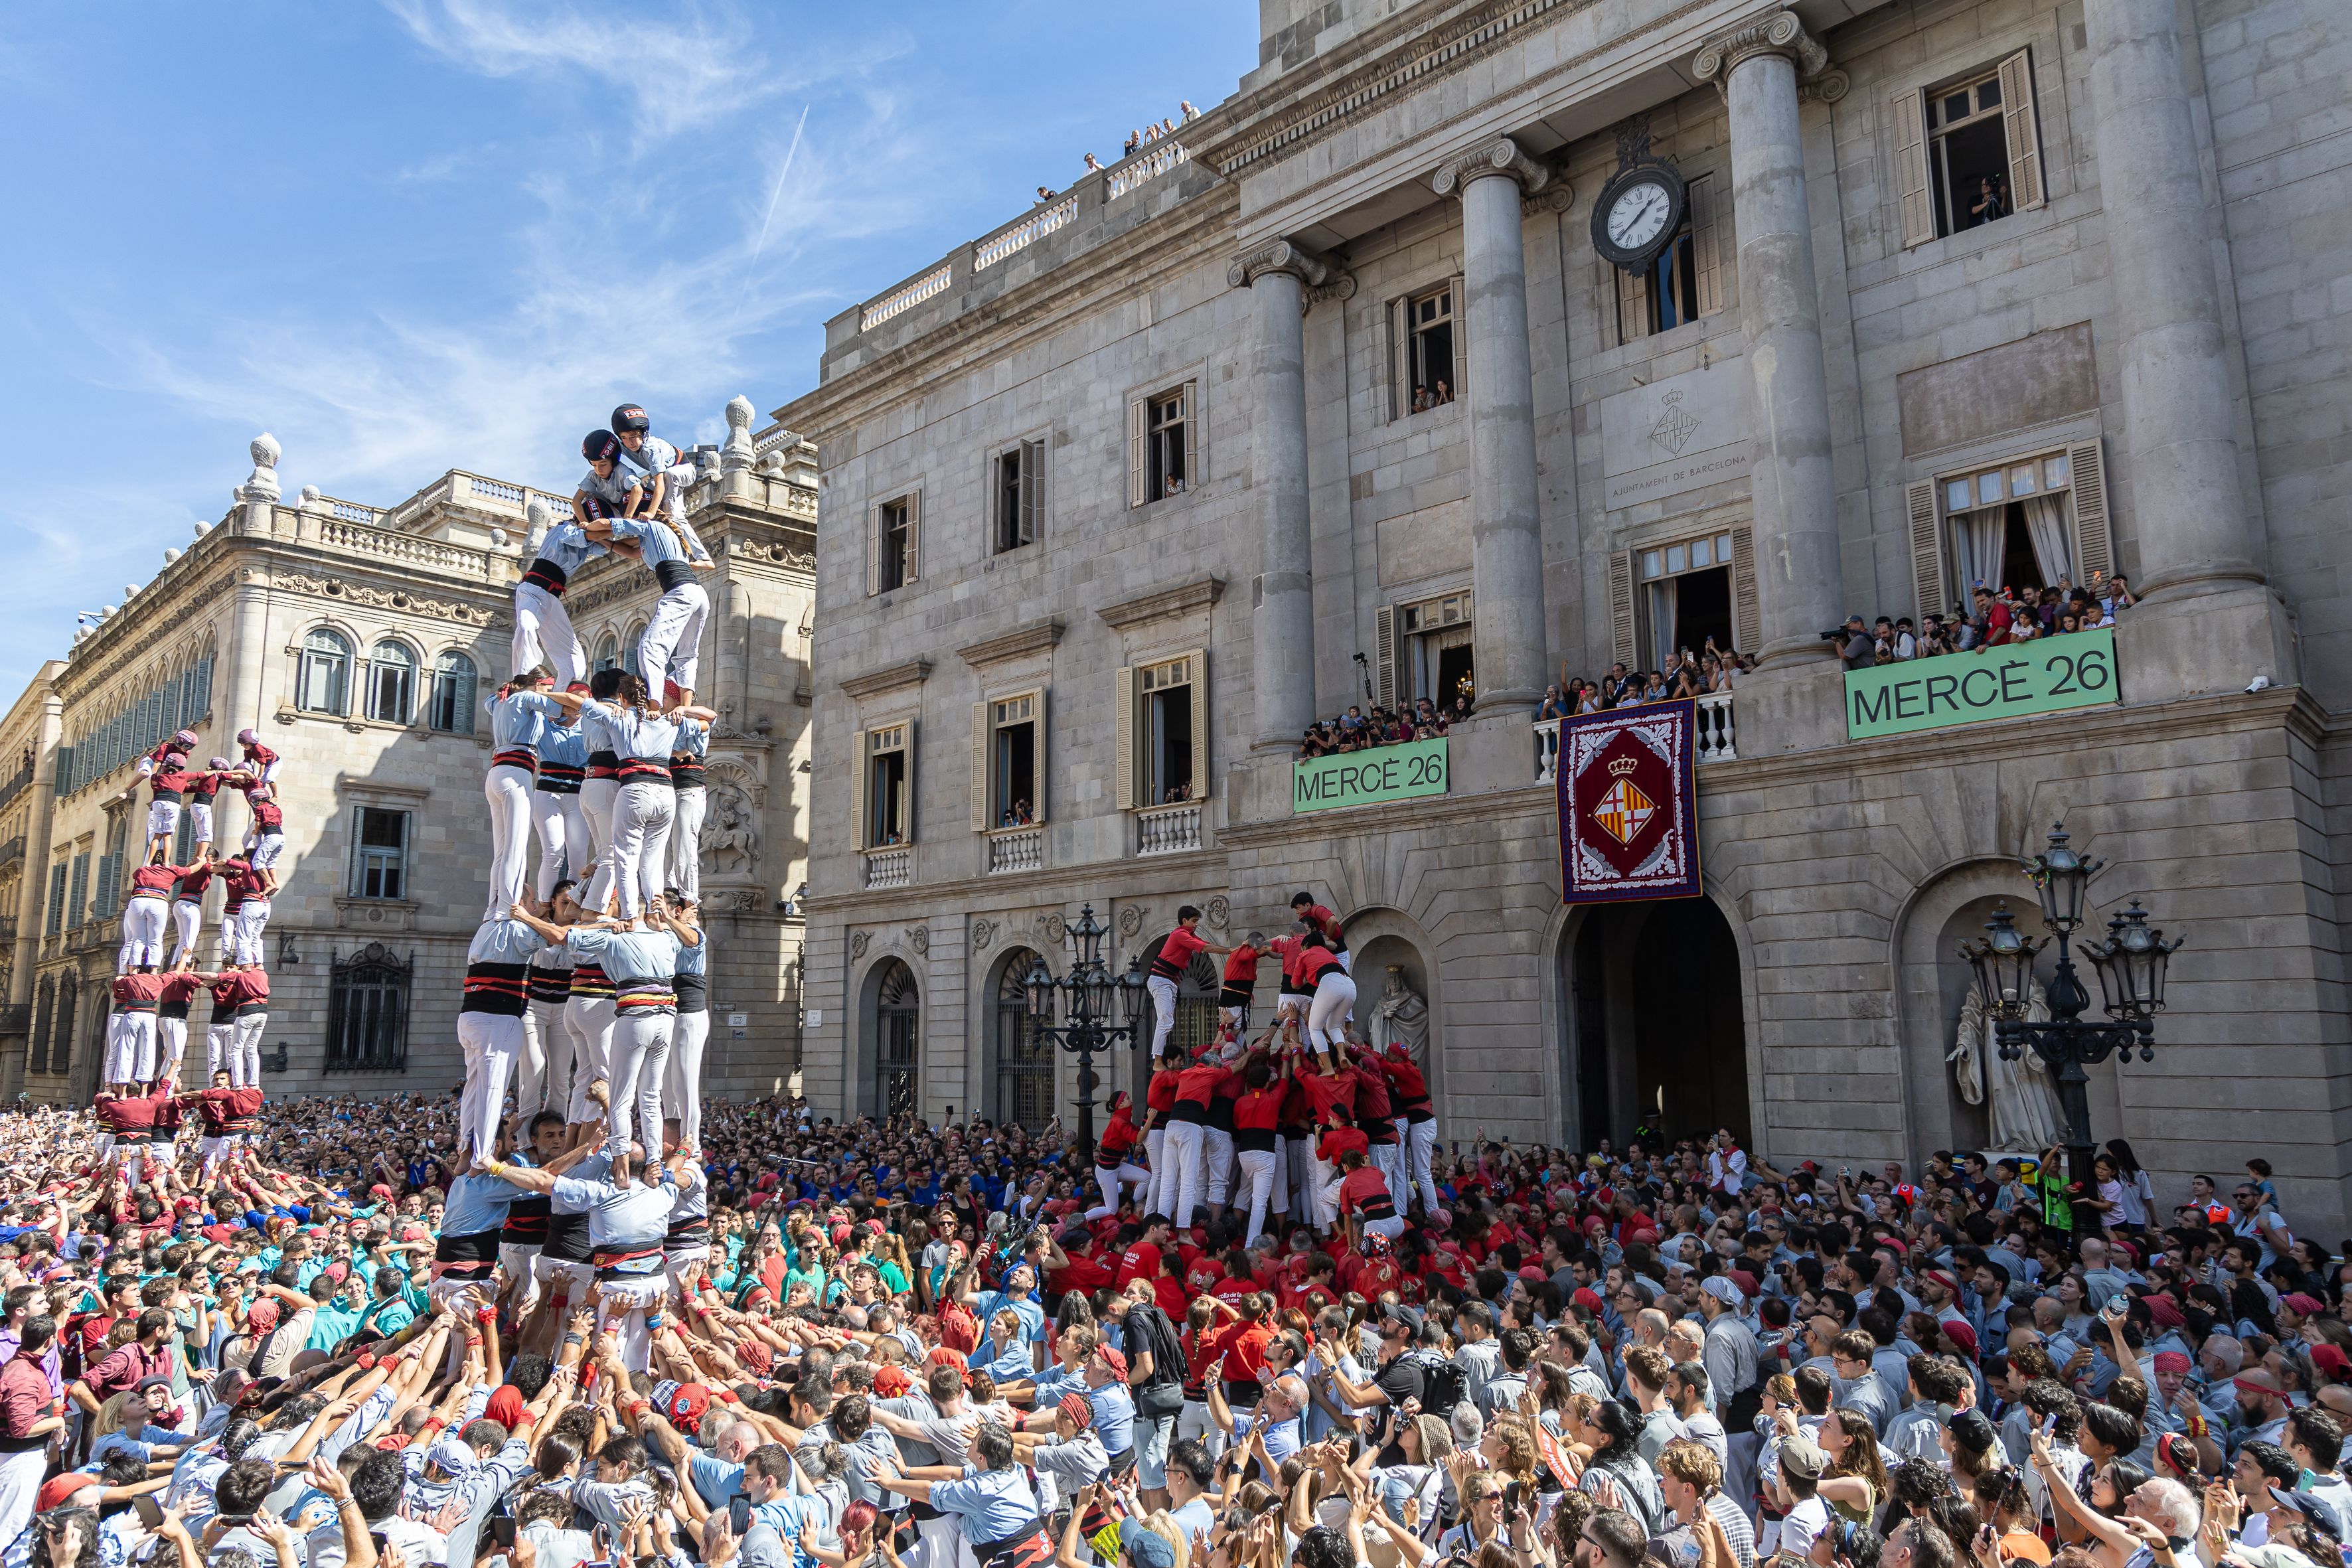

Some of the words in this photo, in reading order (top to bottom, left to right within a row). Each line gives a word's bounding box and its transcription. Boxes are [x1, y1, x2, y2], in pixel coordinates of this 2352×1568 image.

[1612, 475, 1669, 497] AJUNTAMENT
[1673, 471, 1685, 481] DE
[1689, 455, 1747, 477] BARCELONA
[1854, 660, 2033, 726] MERCÈ
[2045, 650, 2109, 696] 26
[1298, 758, 1400, 802] MERCÈ
[1408, 753, 1443, 787] 26
